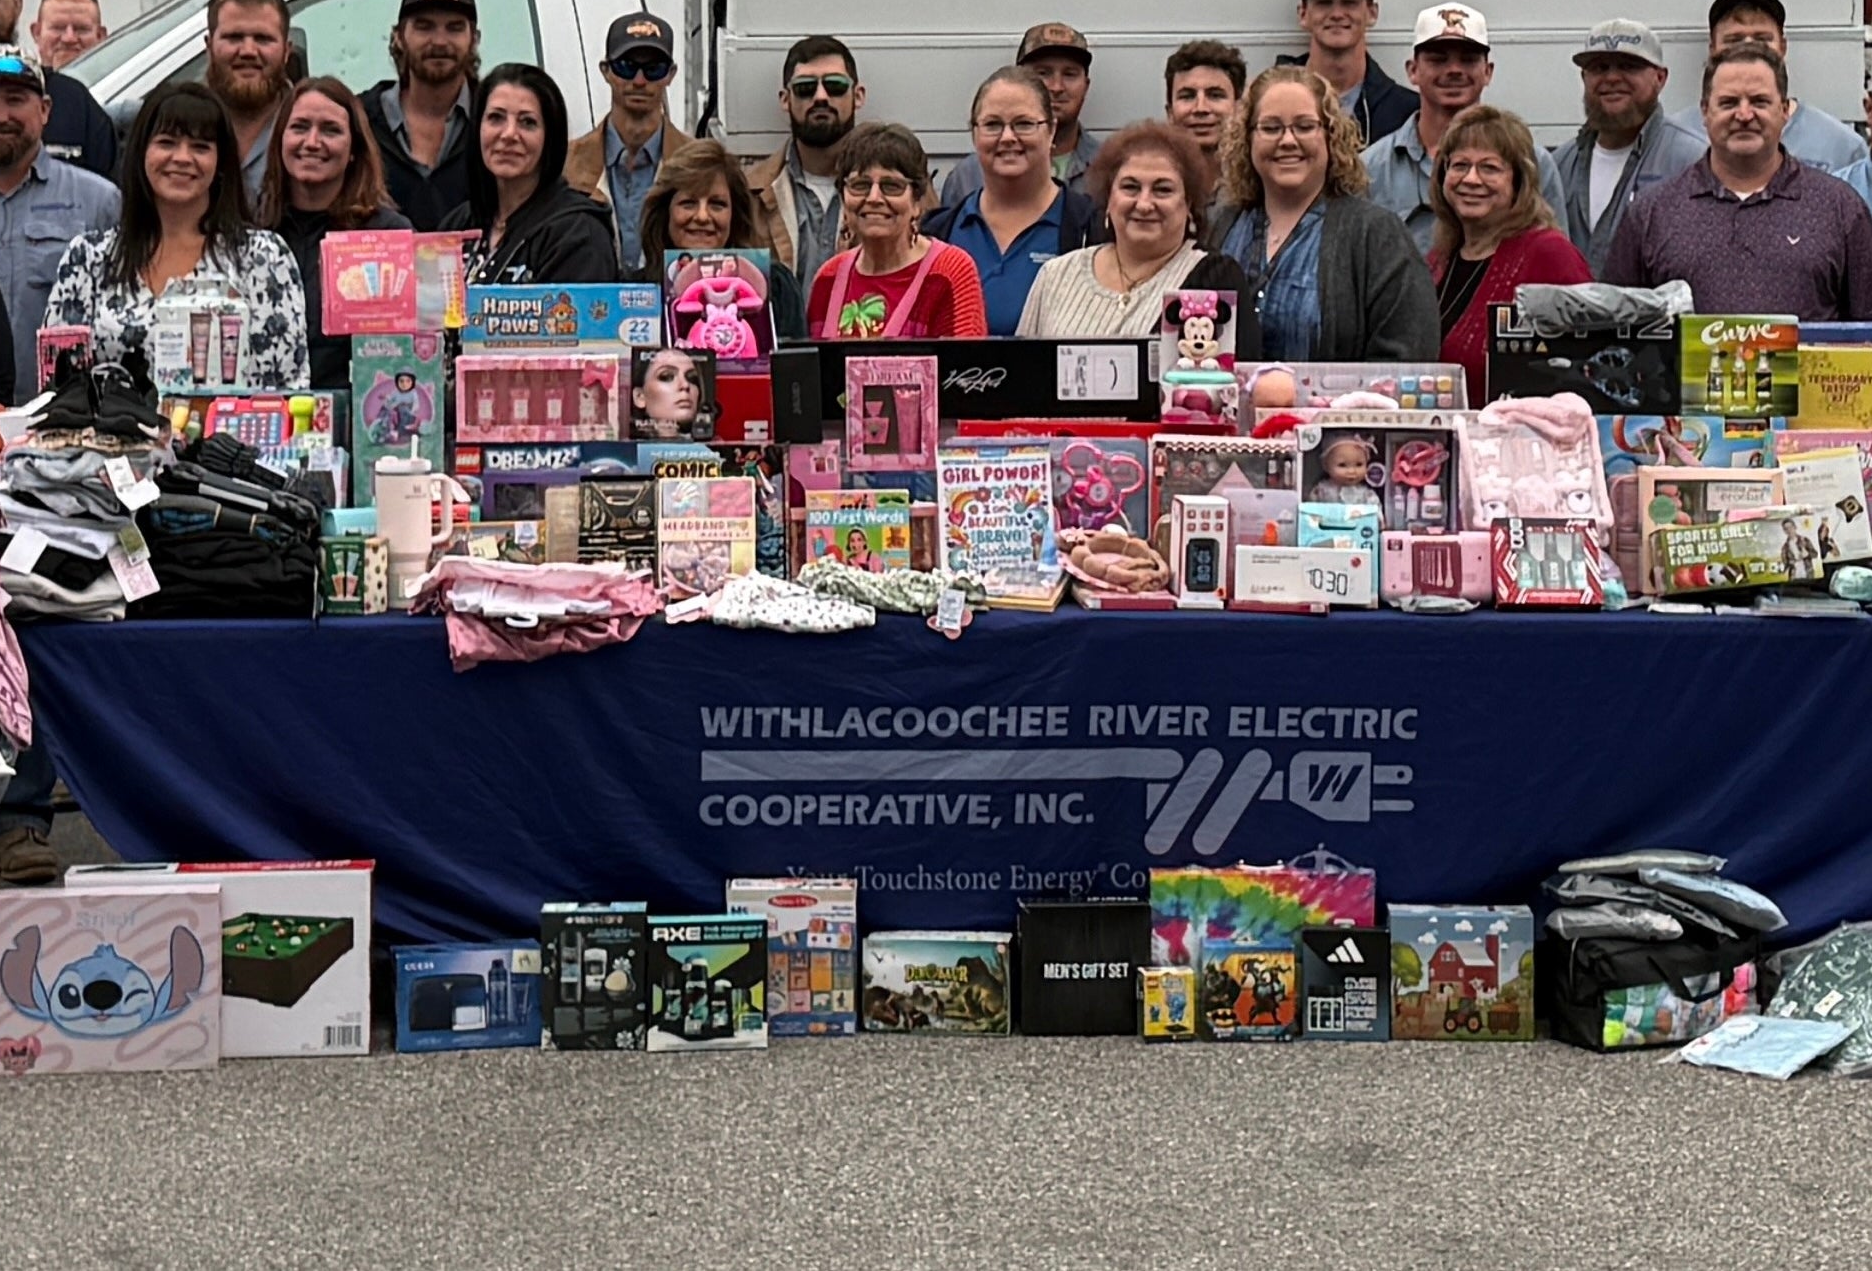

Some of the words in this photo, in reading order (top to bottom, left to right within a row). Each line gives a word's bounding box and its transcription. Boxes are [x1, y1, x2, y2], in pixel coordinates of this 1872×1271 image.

[484, 298, 544, 317] Happy
[488, 317, 540, 333] Paws
[629, 320, 650, 333] 22
[1701, 320, 1780, 345] Curve
[809, 511, 831, 524] 100
[832, 509, 862, 524] First
[864, 509, 905, 523] Words
[1666, 528, 1718, 545] SPORTS
[1668, 543, 1695, 558] FOR
[1697, 540, 1727, 555] KIDS
[700, 705, 1069, 738] WITHLACOOCHEE
[1088, 705, 1210, 737] RIVER
[1228, 706, 1418, 740] ELECTRIC
[698, 793, 1002, 831] COOPERATIVE,
[1014, 792, 1095, 825] INC.
[853, 863, 1002, 892] Touchstone
[652, 926, 702, 942] AXE
[1043, 962, 1080, 979] MEN'S
[1082, 962, 1106, 979] GIFT
[1108, 962, 1129, 978] SET
